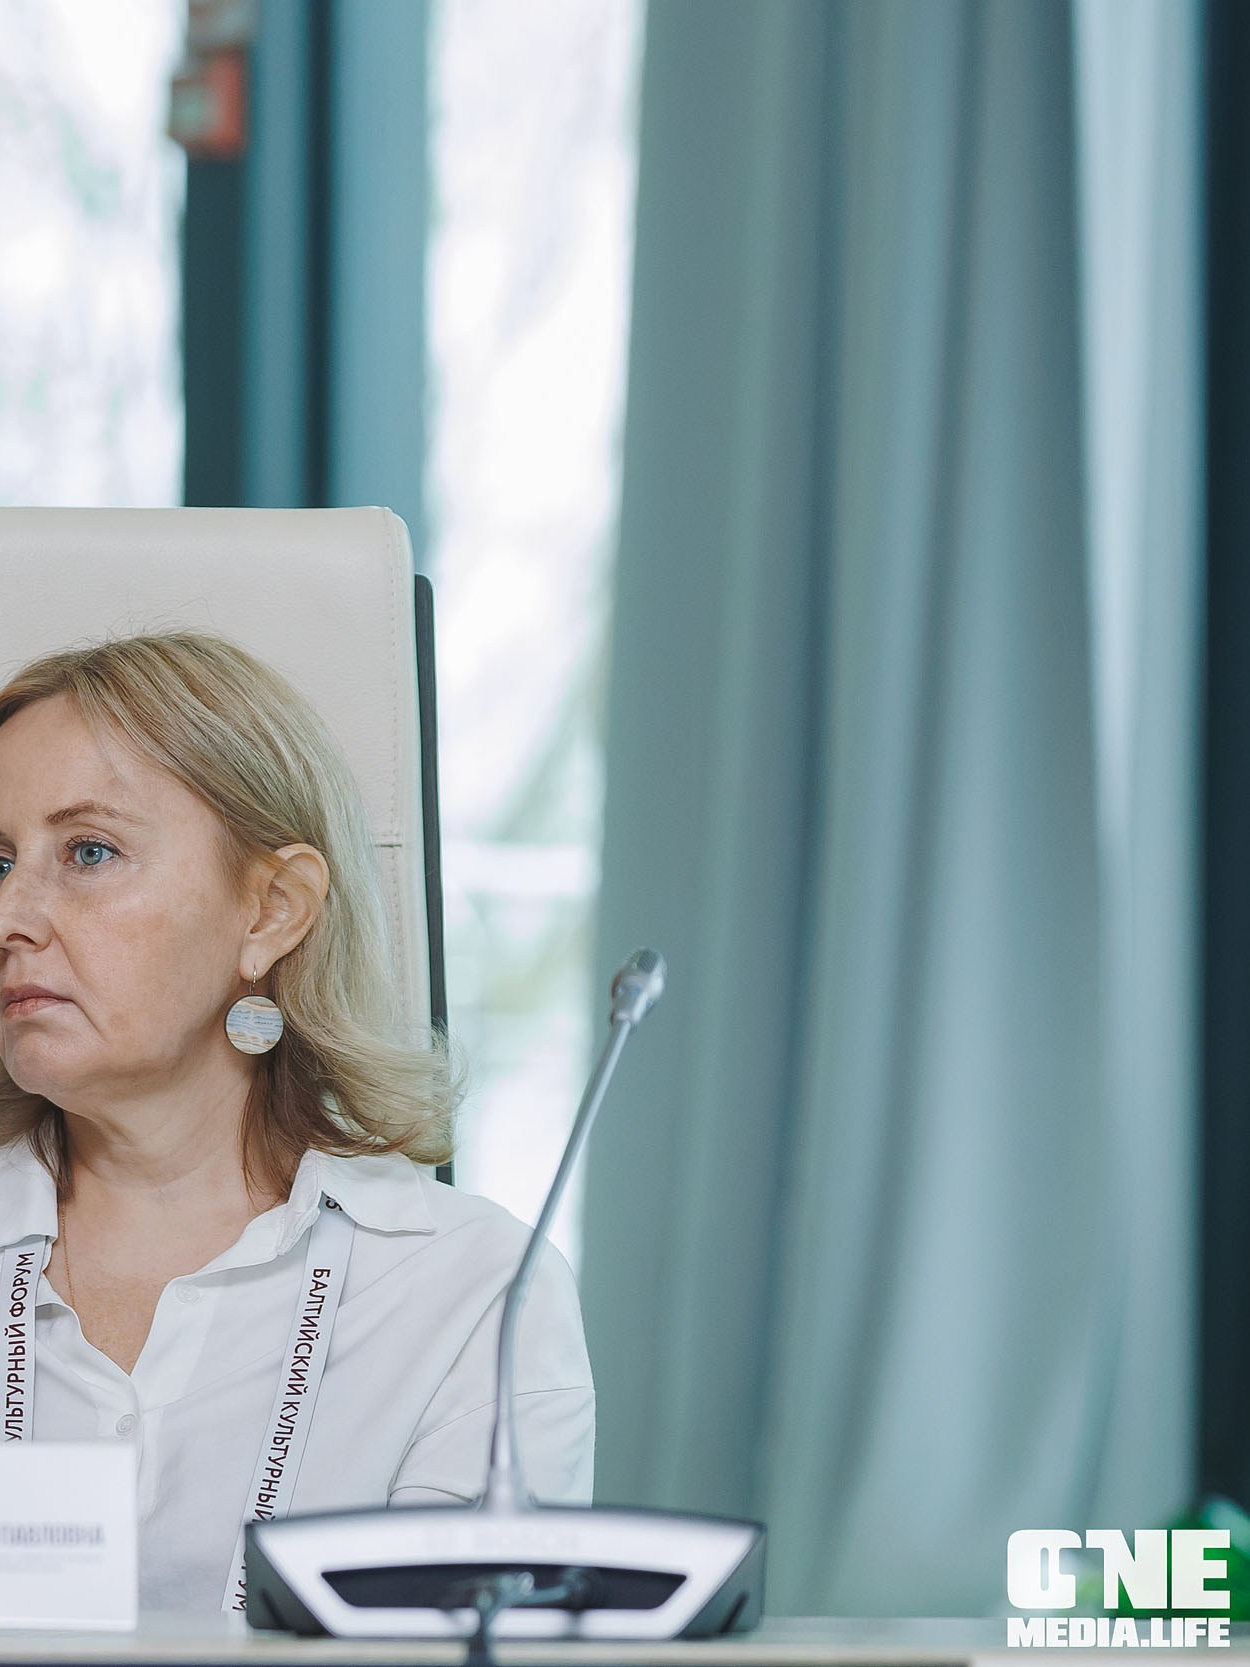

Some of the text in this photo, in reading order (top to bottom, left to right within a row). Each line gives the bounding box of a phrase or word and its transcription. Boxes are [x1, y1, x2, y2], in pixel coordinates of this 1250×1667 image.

[4, 1252, 35, 1444] УЛЬТУРНЫЙ ФОРУМ
[252, 1267, 331, 1524] БАЛТИЙСКИЙ КУЛЬТУРНЫЙ
